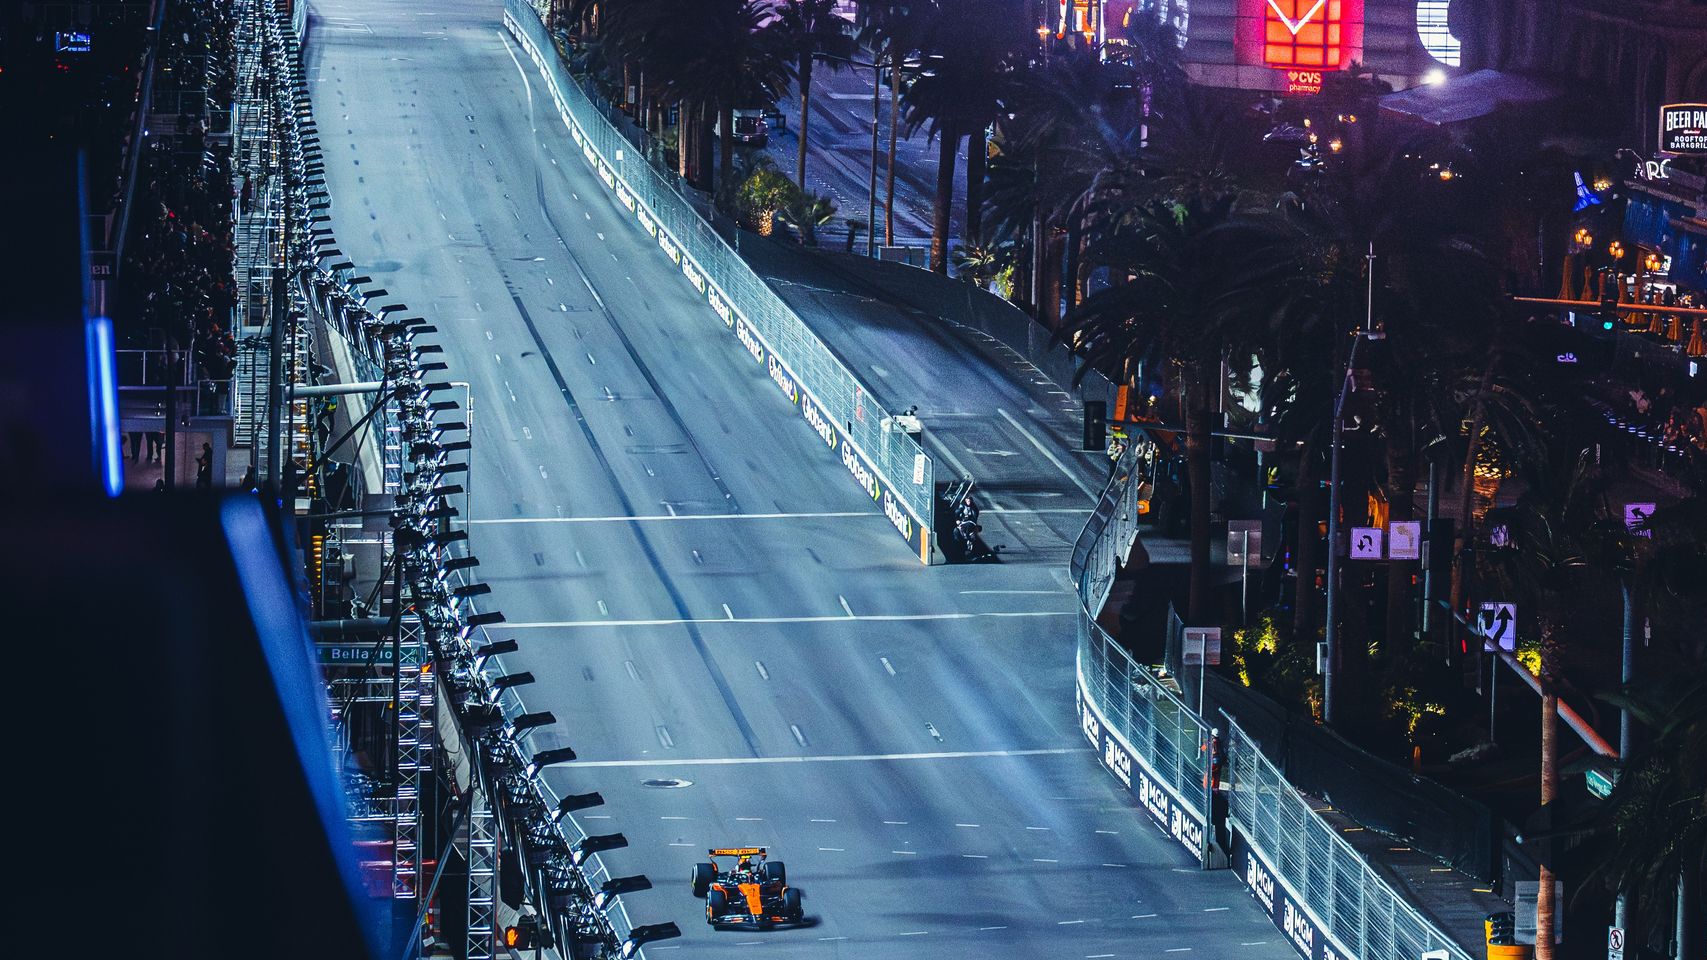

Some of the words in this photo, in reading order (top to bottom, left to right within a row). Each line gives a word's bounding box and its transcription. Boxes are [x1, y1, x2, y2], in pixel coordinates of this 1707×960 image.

[1289, 83, 1321, 95] pharmacy
[1298, 71, 1321, 83] CVS
[1666, 111, 1691, 131] BEER
[802, 393, 832, 447] Globant
[841, 440, 876, 498] Globant
[883, 489, 909, 540] Globant
[1114, 747, 1131, 778] MGM
[1149, 781, 1168, 813] MGM
[1182, 814, 1202, 849] MGM
[1256, 863, 1274, 901] MGM
[1294, 909, 1313, 948] MGM
